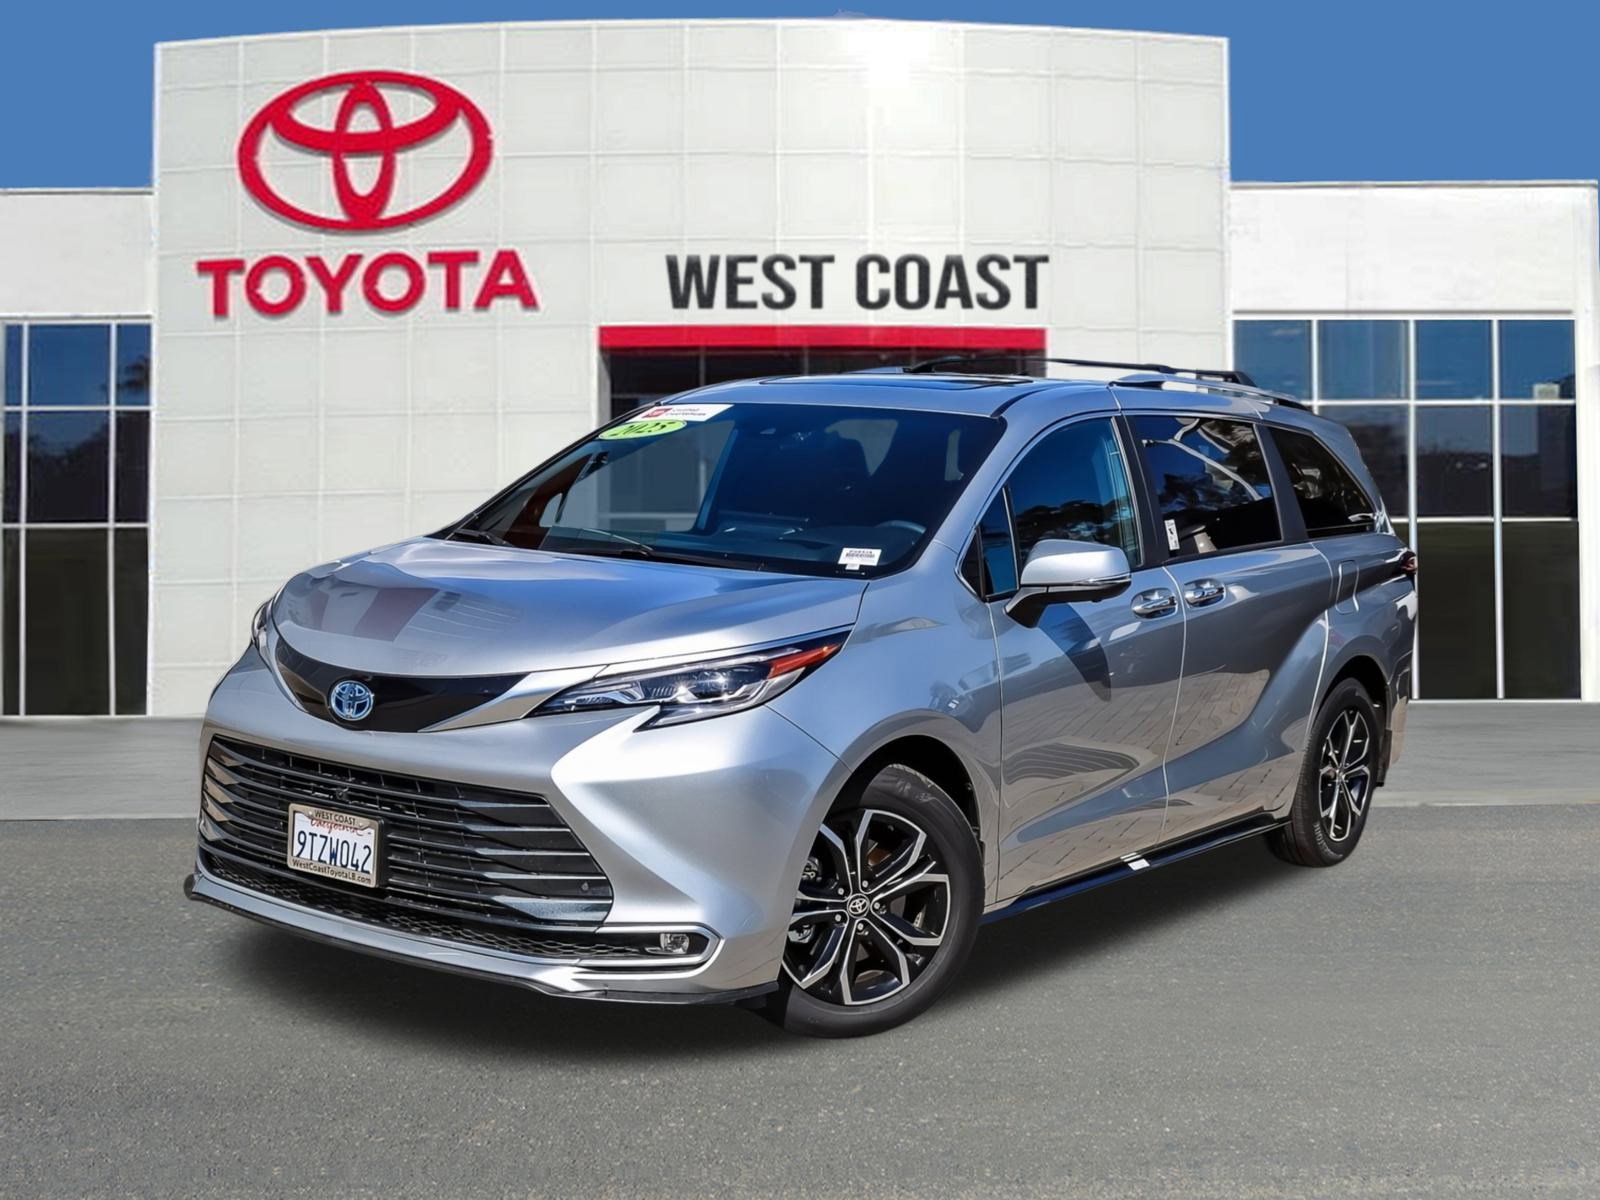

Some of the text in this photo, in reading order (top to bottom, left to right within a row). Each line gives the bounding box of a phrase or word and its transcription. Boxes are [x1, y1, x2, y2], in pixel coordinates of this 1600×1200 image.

[196, 249, 539, 317] TOYOTA
[665, 253, 1050, 310] WEST COAST
[608, 421, 677, 437] 2025
[314, 810, 356, 826] WEST COAST
[296, 830, 372, 874] 9TZW042
[292, 859, 372, 885] WestCoastToyotaLB.com
